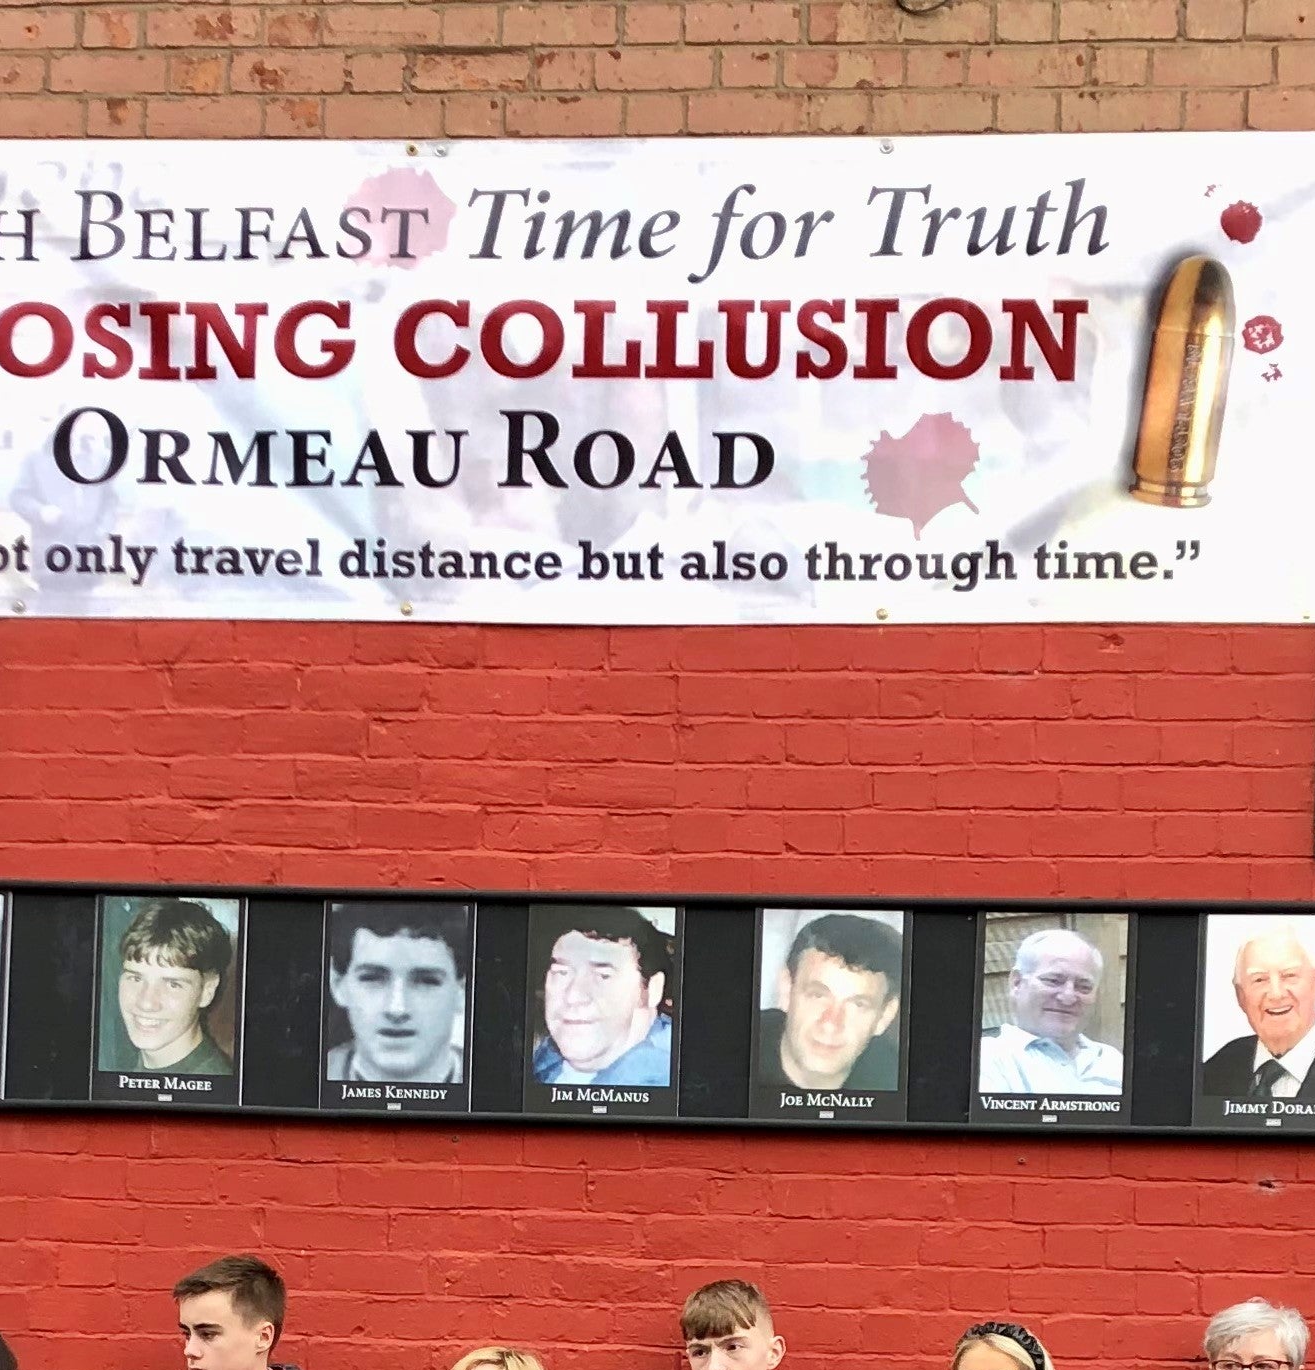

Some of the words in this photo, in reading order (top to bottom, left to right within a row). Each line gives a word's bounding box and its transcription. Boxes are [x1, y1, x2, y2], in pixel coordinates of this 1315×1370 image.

[70, 189, 429, 262] BELFAST
[468, 186, 677, 262] Time
[687, 184, 834, 284] for
[867, 177, 1109, 261] Truth
[393, 297, 1088, 382] COLLUSION
[52, 407, 468, 488] ORMEAU
[497, 409, 774, 490] ROAD
[45, 533, 157, 586] only
[171, 537, 322, 577] travel
[339, 537, 562, 580] distance
[577, 539, 664, 580] but
[680, 540, 788, 581] also
[804, 539, 1017, 592] through
[1033, 540, 1200, 580] time.”
[118, 1074, 160, 1089] PETER
[163, 1076, 212, 1091] MAGEE
[341, 1084, 381, 1099] JAMES
[384, 1085, 447, 1099] KENNEDY
[551, 1087, 573, 1102] JIM
[780, 1092, 803, 1108] JOE
[980, 1096, 1037, 1110] VINCENT
[1038, 1097, 1120, 1112] ARMSTRONG
[1223, 1100, 1269, 1118] JIMMY
